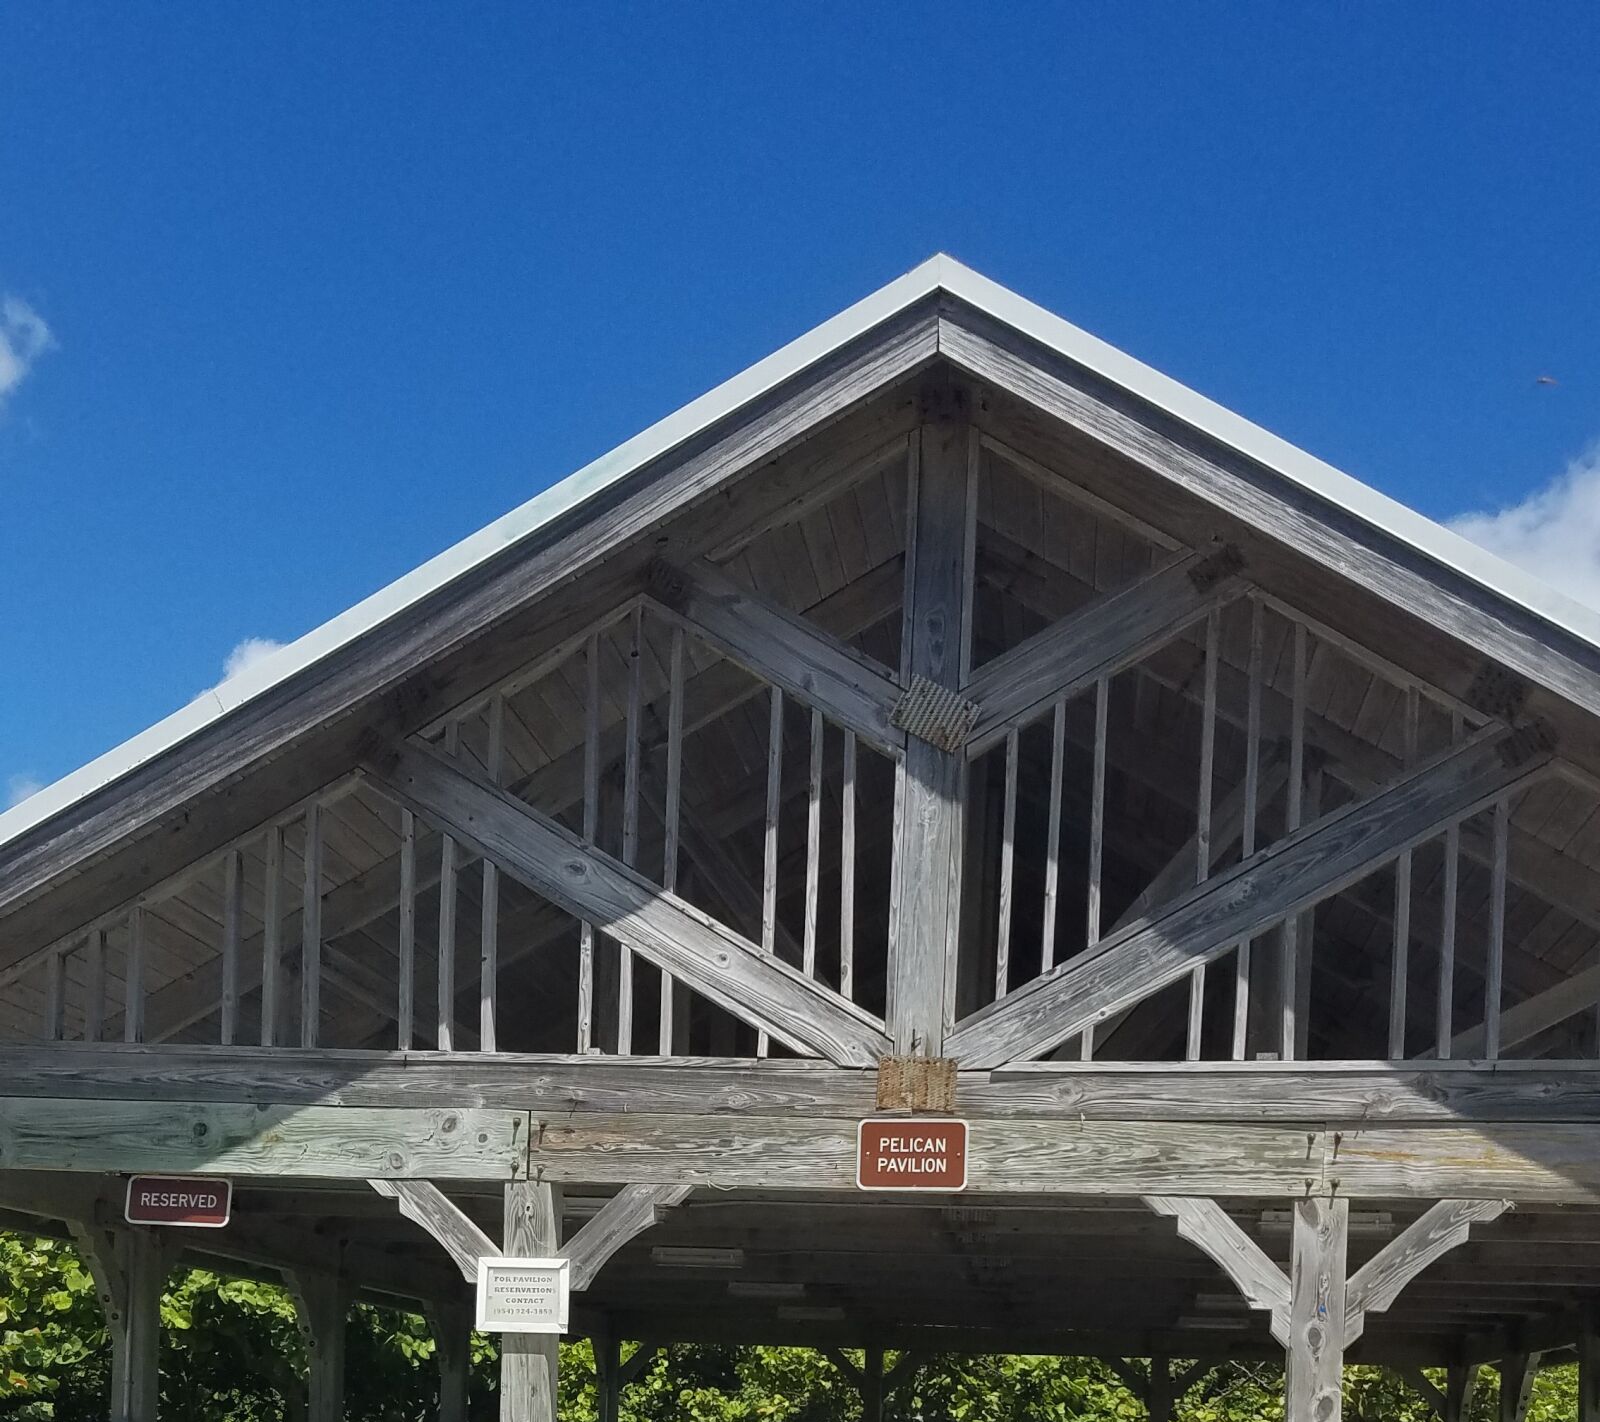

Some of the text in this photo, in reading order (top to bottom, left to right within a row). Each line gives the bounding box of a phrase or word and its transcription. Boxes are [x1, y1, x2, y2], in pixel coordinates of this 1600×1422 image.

[879, 1137, 947, 1153] PELICAN
[877, 1157, 947, 1173] PAVILION
[140, 1192, 217, 1208] RESERVED
